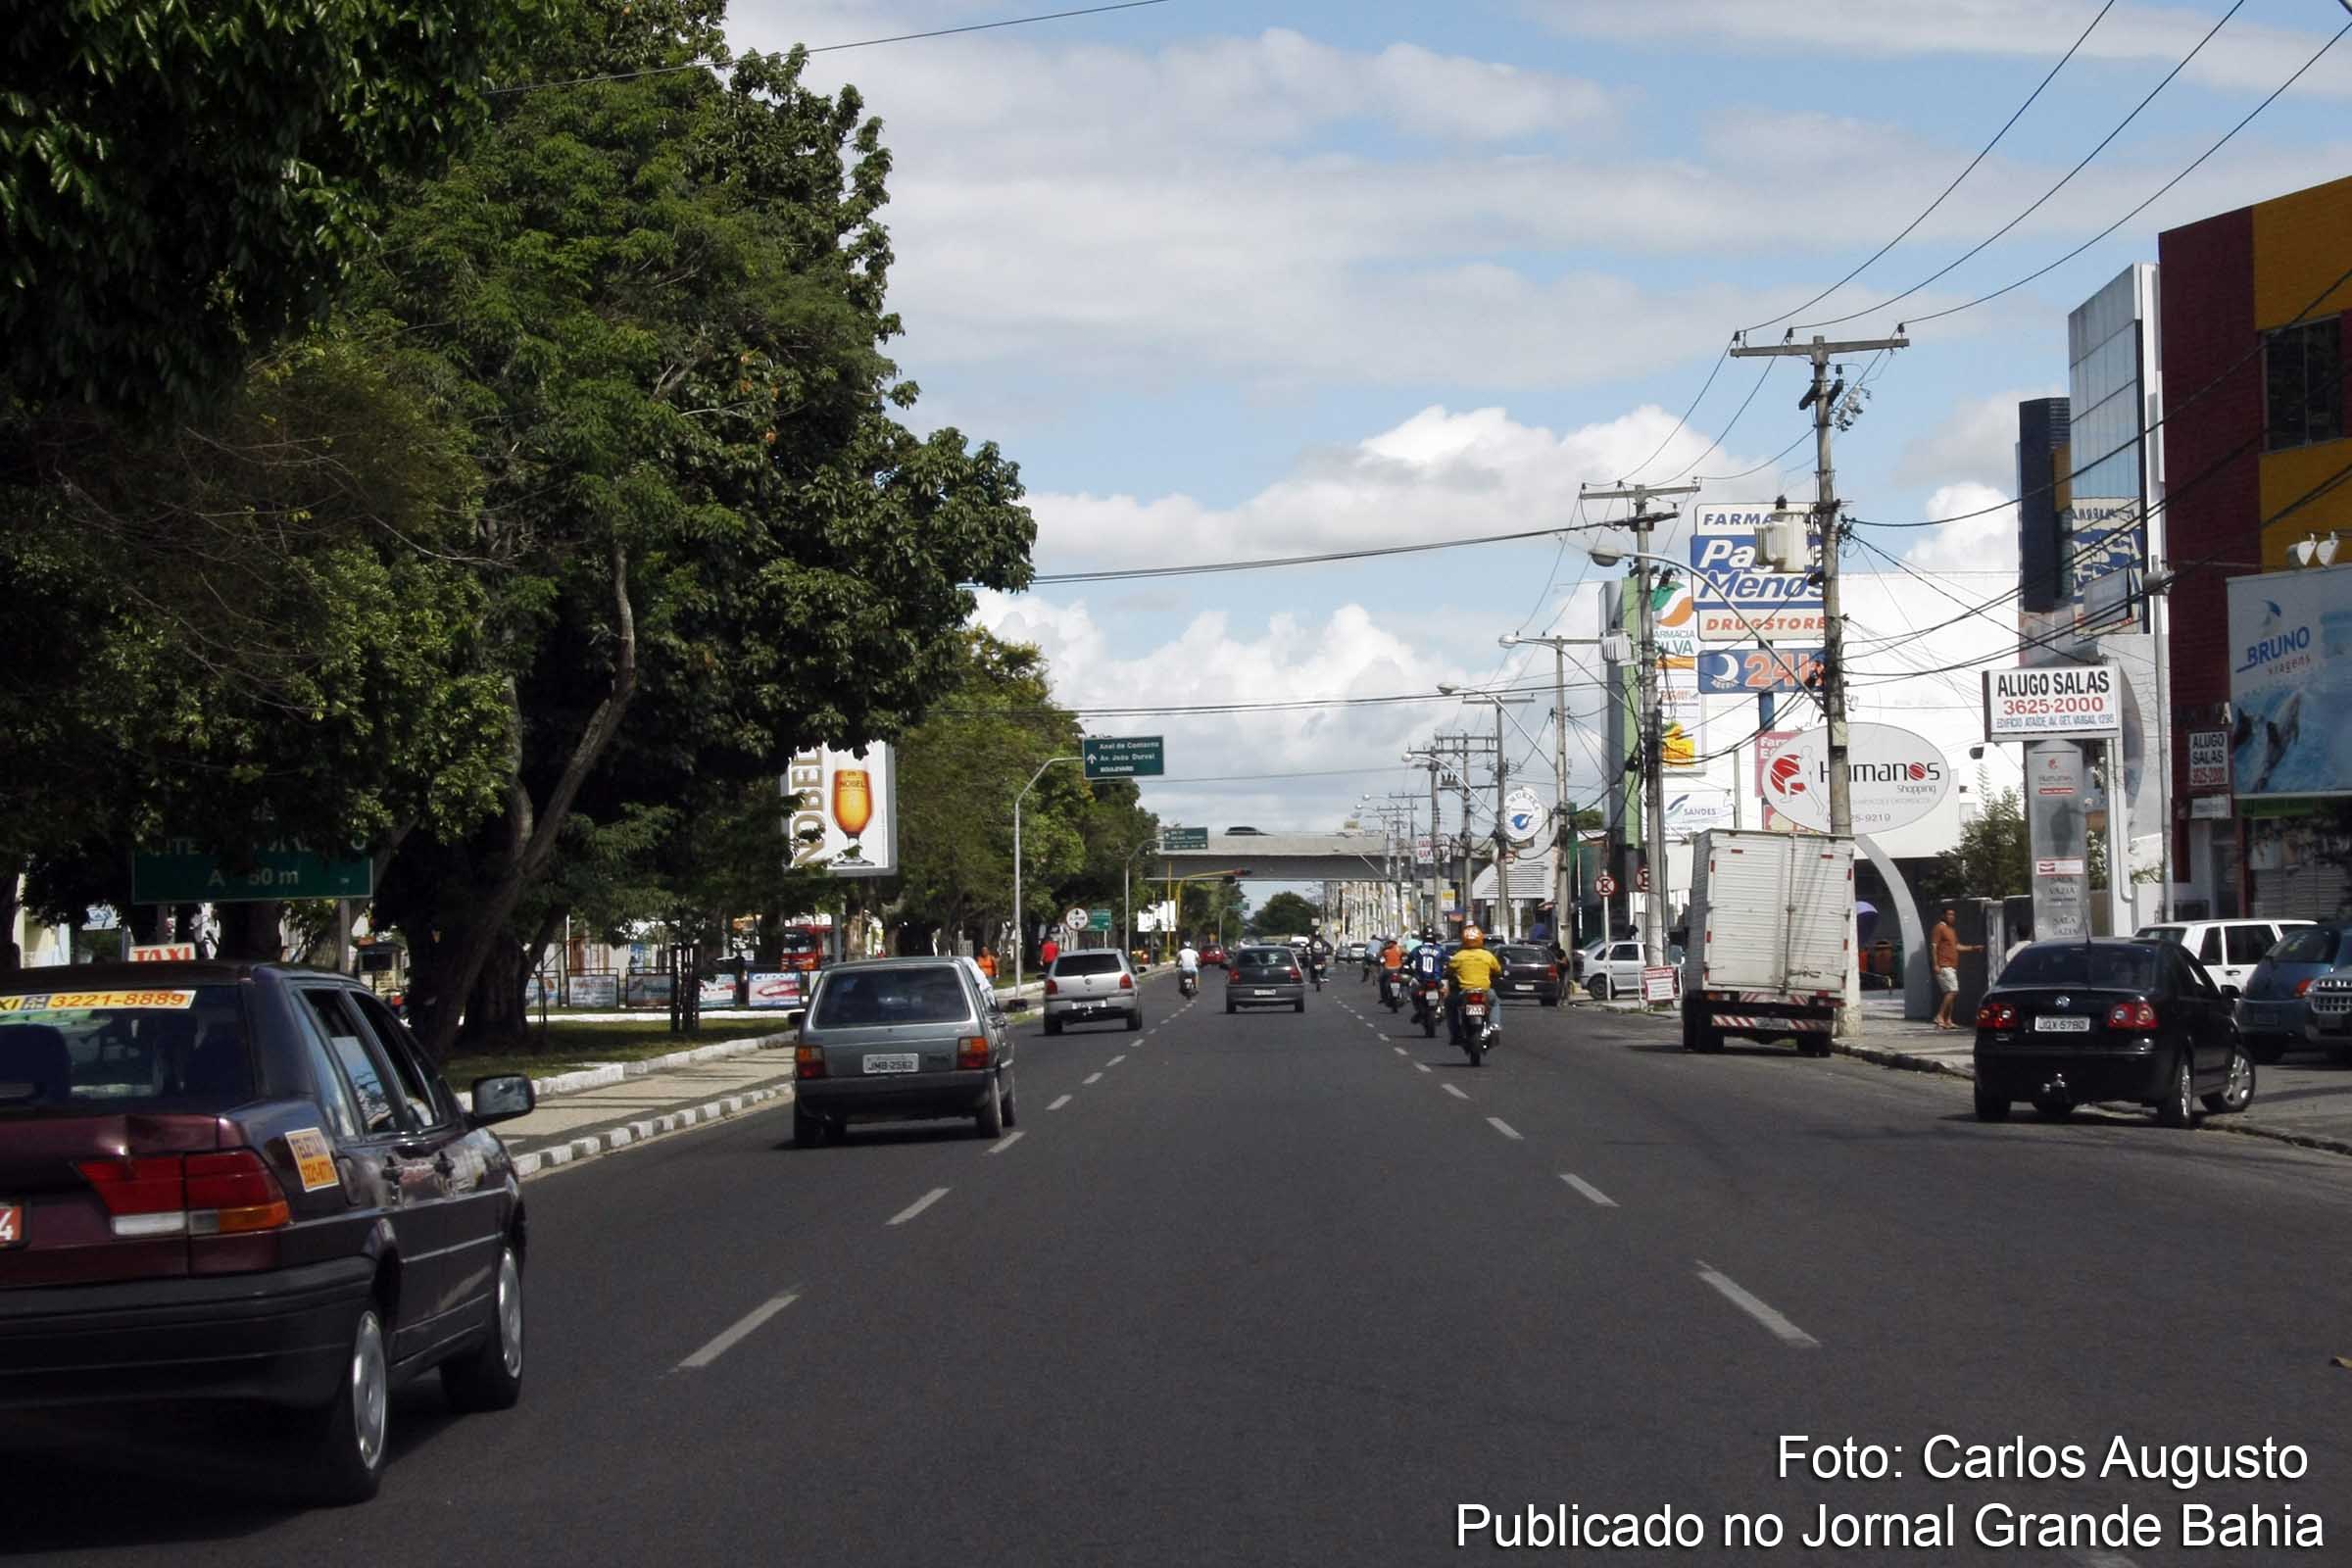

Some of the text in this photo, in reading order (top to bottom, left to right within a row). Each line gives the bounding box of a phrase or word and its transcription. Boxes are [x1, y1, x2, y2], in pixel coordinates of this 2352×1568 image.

[1705, 617, 1827, 630] DRUGSTORE
[2244, 625, 2311, 666] BRUNO
[1997, 670, 2110, 697] ALUGO SALAS
[2192, 733, 2226, 749] ALUGO
[2191, 749, 2225, 765] SALAS
[1896, 784, 1937, 795] Shopping
[792, 745, 826, 866] NOBEL
[1684, 808, 1717, 816] SANDES
[133, 947, 191, 961] TAXI
[1422, 956, 1434, 972] 10
